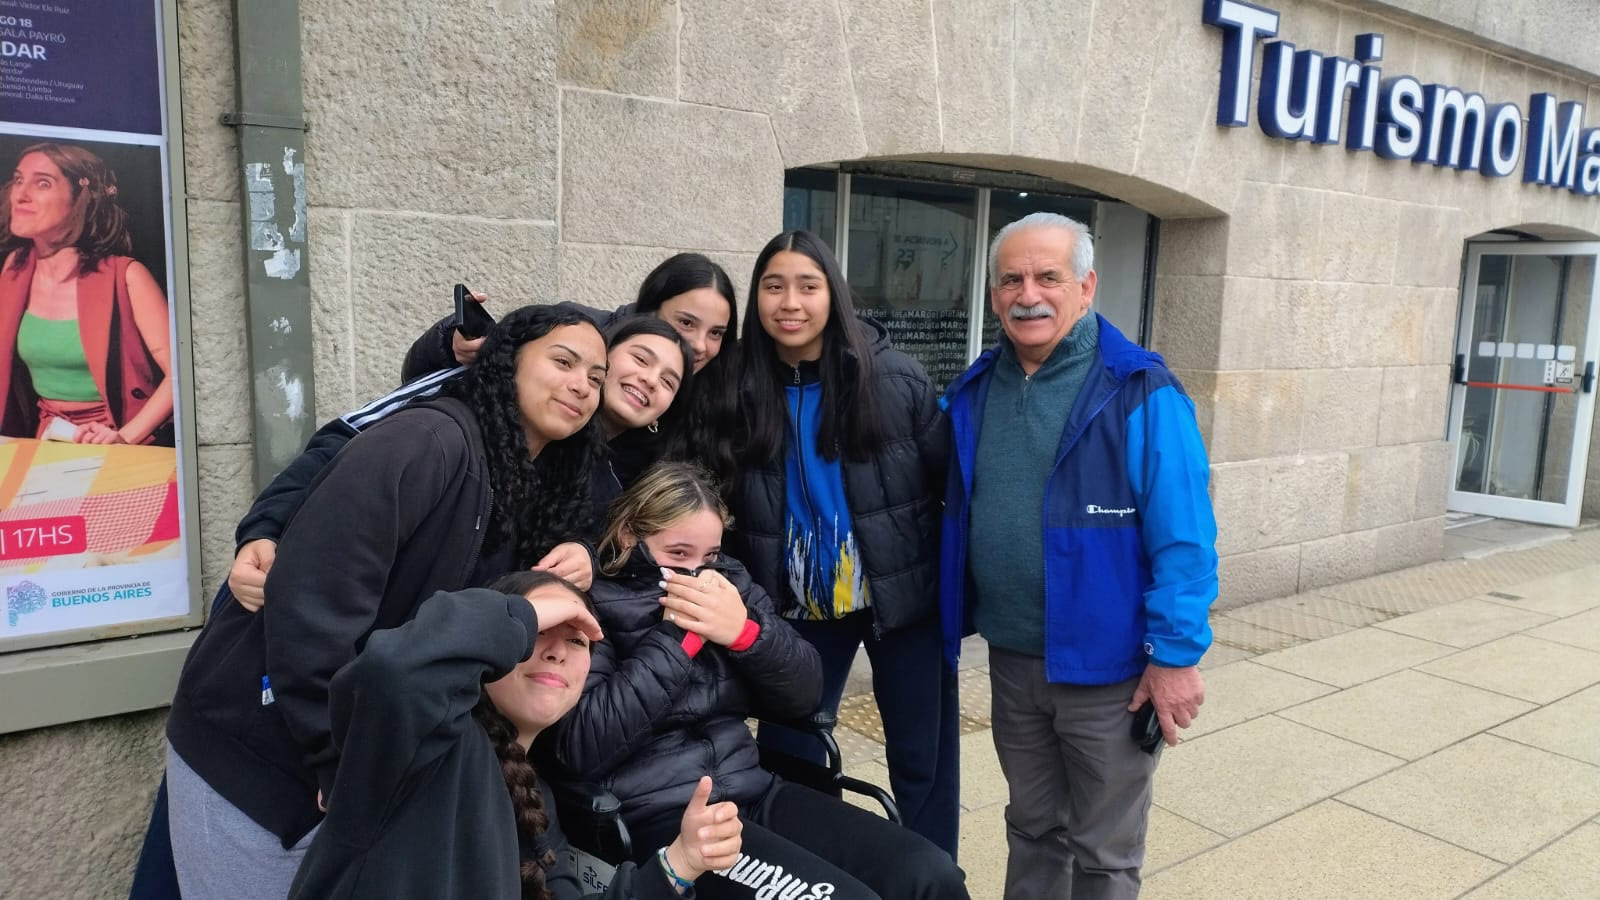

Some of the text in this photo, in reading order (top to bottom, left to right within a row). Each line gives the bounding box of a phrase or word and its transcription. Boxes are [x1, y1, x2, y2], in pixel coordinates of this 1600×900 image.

[19, 18, 33, 28] 18
[29, 30, 66, 43] PAYRÓ
[2, 41, 47, 61] DAR
[1203, 0, 1522, 178] Turismo
[12, 524, 73, 549] 17HS
[51, 588, 87, 597] GOBIERNO
[107, 582, 141, 591] PROVINCIA
[52, 587, 152, 608] BUENOS AIRES
